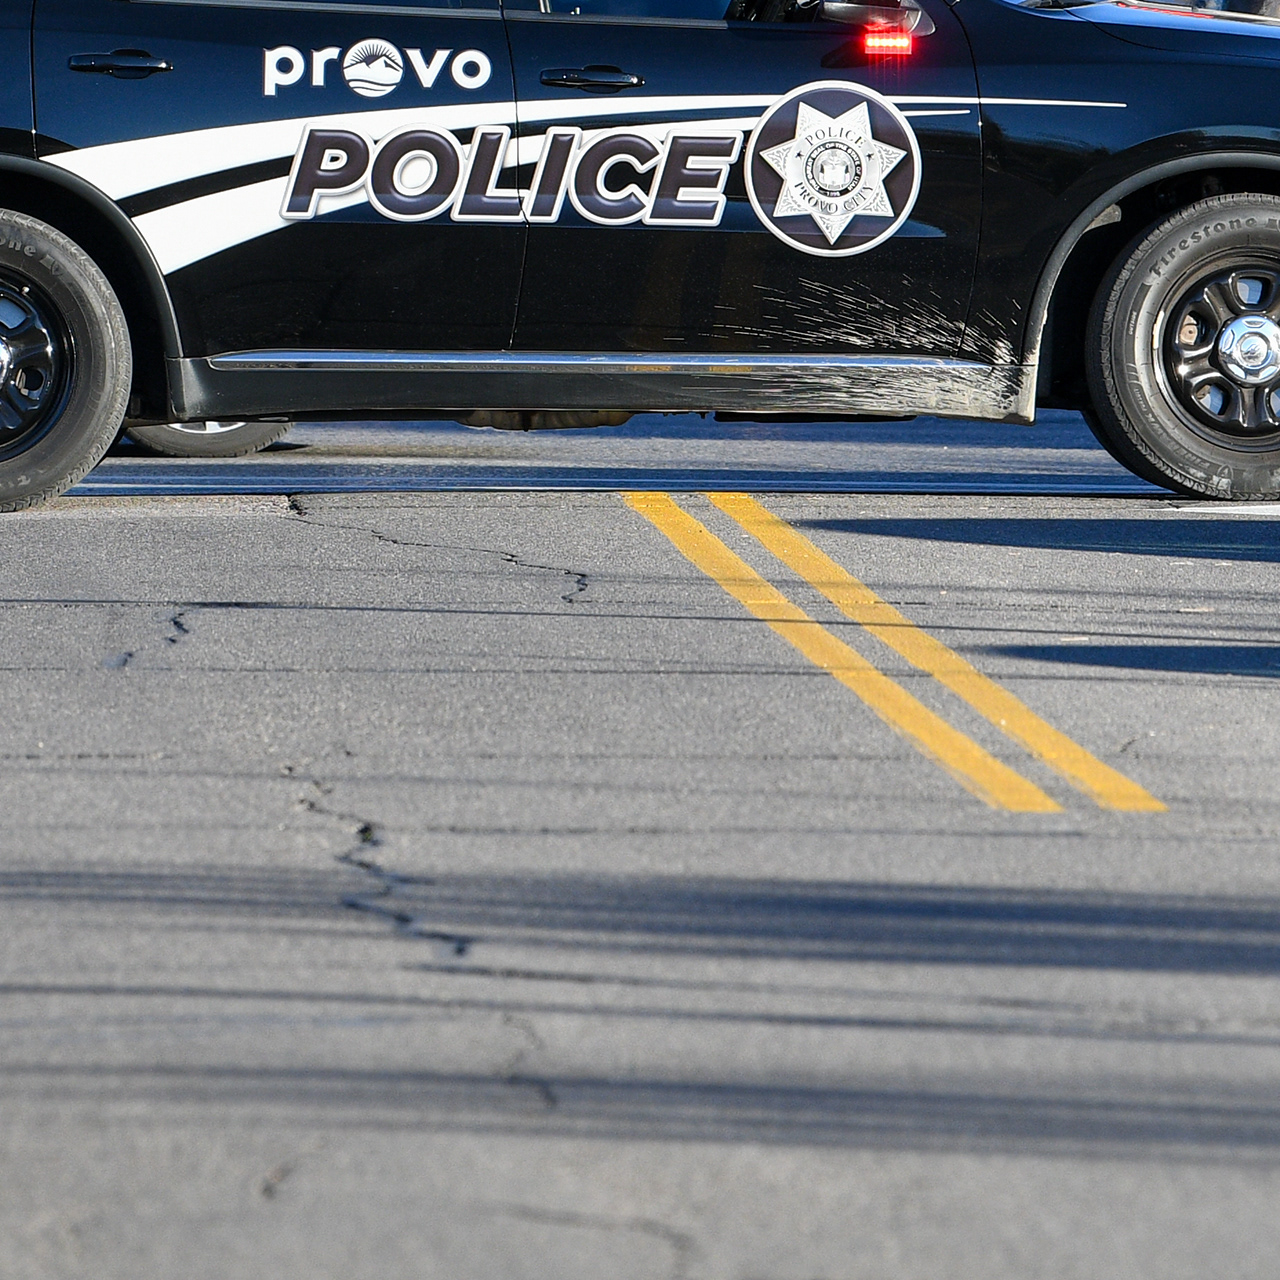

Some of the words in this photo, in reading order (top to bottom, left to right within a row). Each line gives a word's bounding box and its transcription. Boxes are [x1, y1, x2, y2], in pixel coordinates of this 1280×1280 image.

[263, 37, 492, 98] provo
[804, 126, 867, 149] POLICE
[280, 123, 740, 225] POLICE
[794, 181, 838, 214] PROVO
[843, 184, 874, 212] CITY
[1149, 217, 1259, 278] Firestone
[1128, 311, 1137, 335] OUTSIDE
